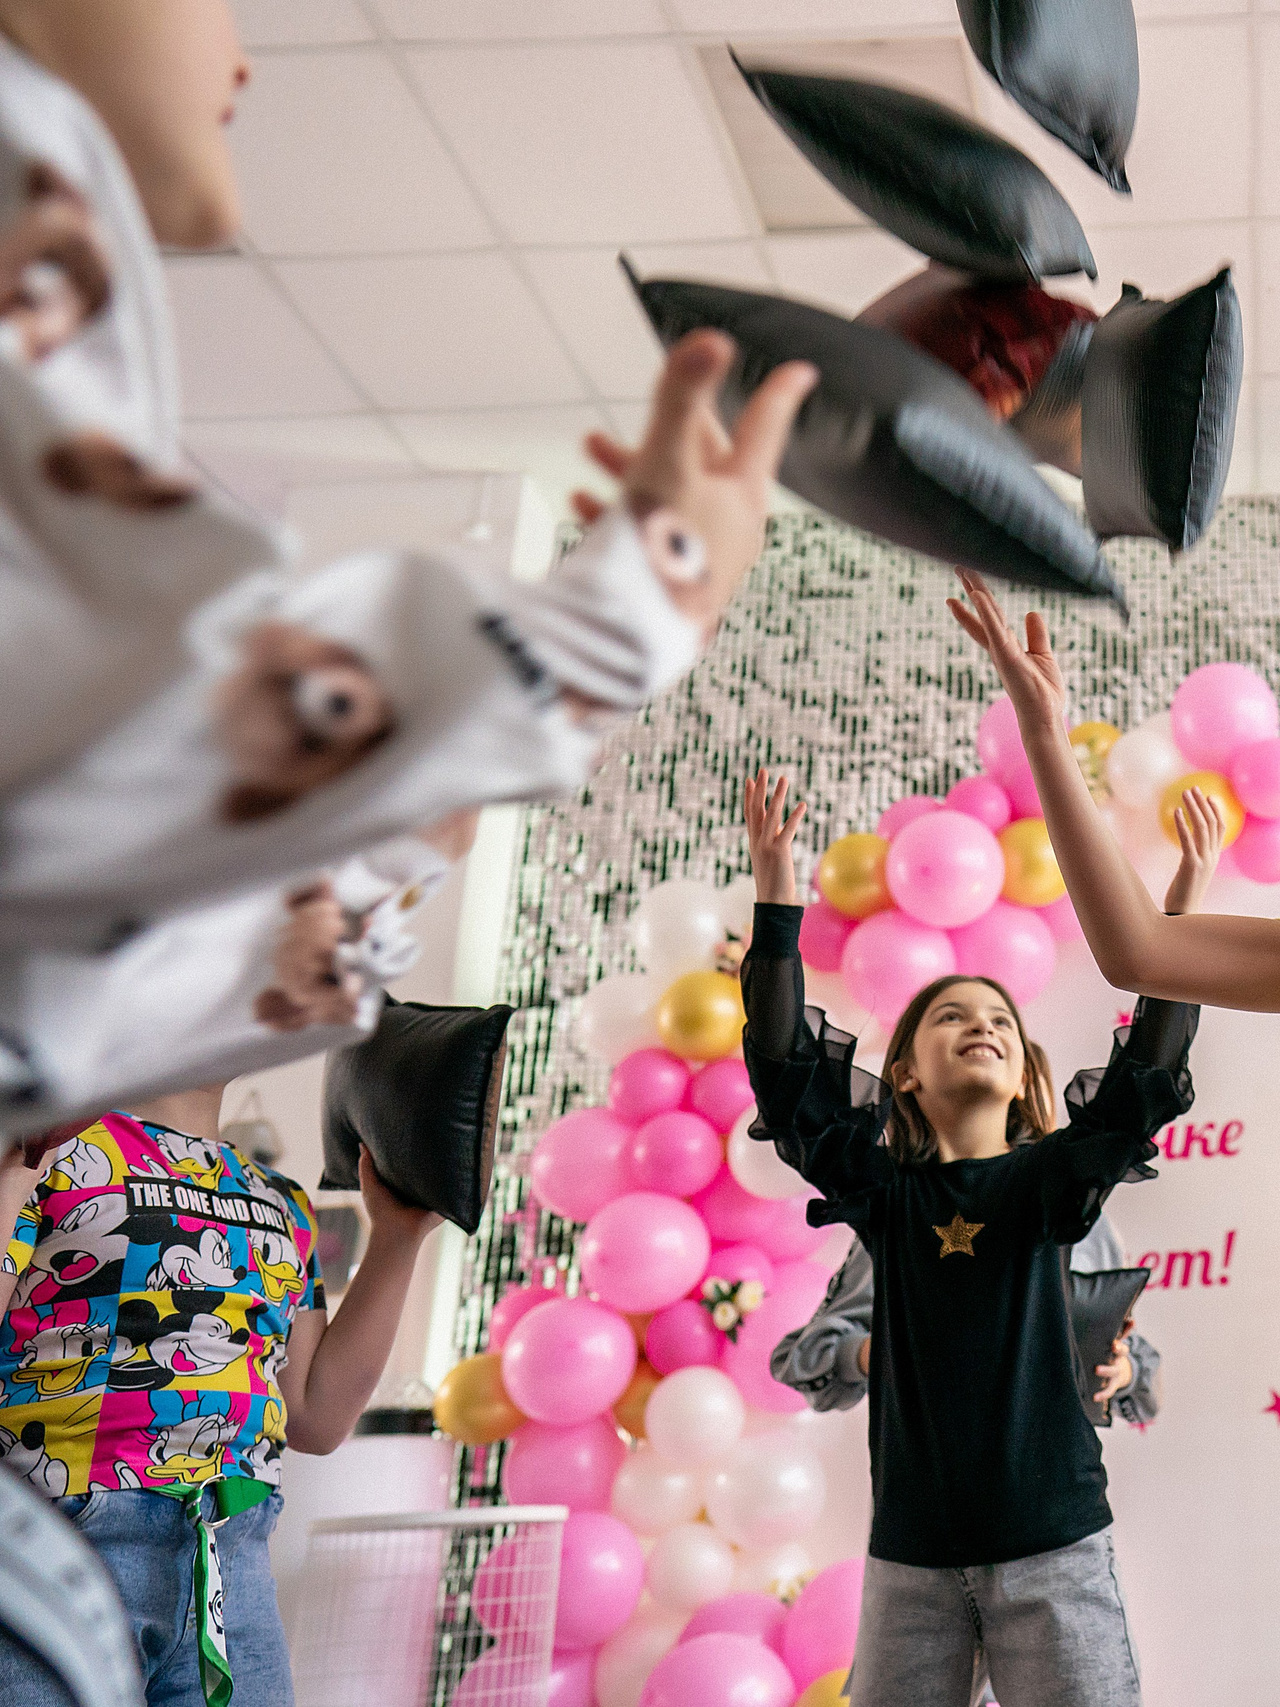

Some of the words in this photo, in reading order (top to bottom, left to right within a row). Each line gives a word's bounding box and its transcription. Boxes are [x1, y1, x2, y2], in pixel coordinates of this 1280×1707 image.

[128, 1182, 174, 1208] THE
[174, 1185, 214, 1216] ONE
[211, 1195, 251, 1222] AND
[250, 1201, 286, 1232] ONLY
